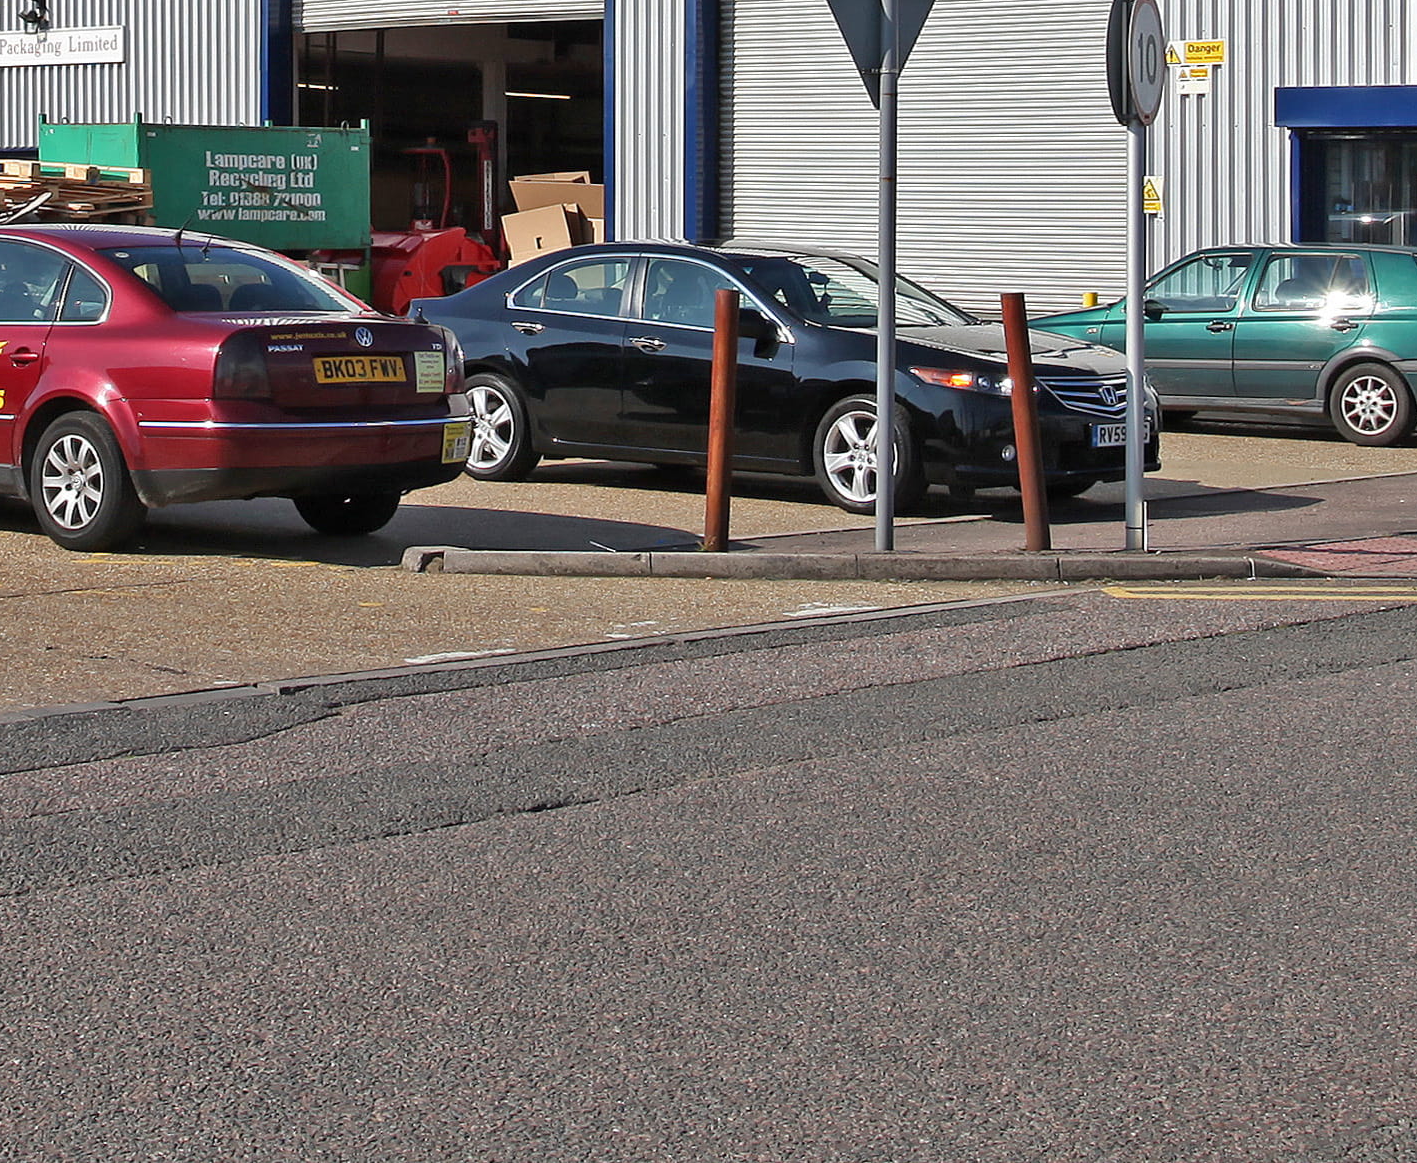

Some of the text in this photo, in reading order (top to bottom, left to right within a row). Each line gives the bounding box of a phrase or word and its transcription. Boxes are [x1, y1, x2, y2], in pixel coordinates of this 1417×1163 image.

[0, 39, 62, 57] Packaging
[69, 34, 118, 53] Limited
[1187, 42, 1222, 55] Danger
[1138, 32, 1157, 85] 10
[205, 151, 318, 170] Lampcare (UK)
[209, 170, 314, 190] Recycling Ltd
[202, 191, 226, 206] Tel:
[267, 344, 304, 353] PASSAT
[321, 359, 367, 379] BK03
